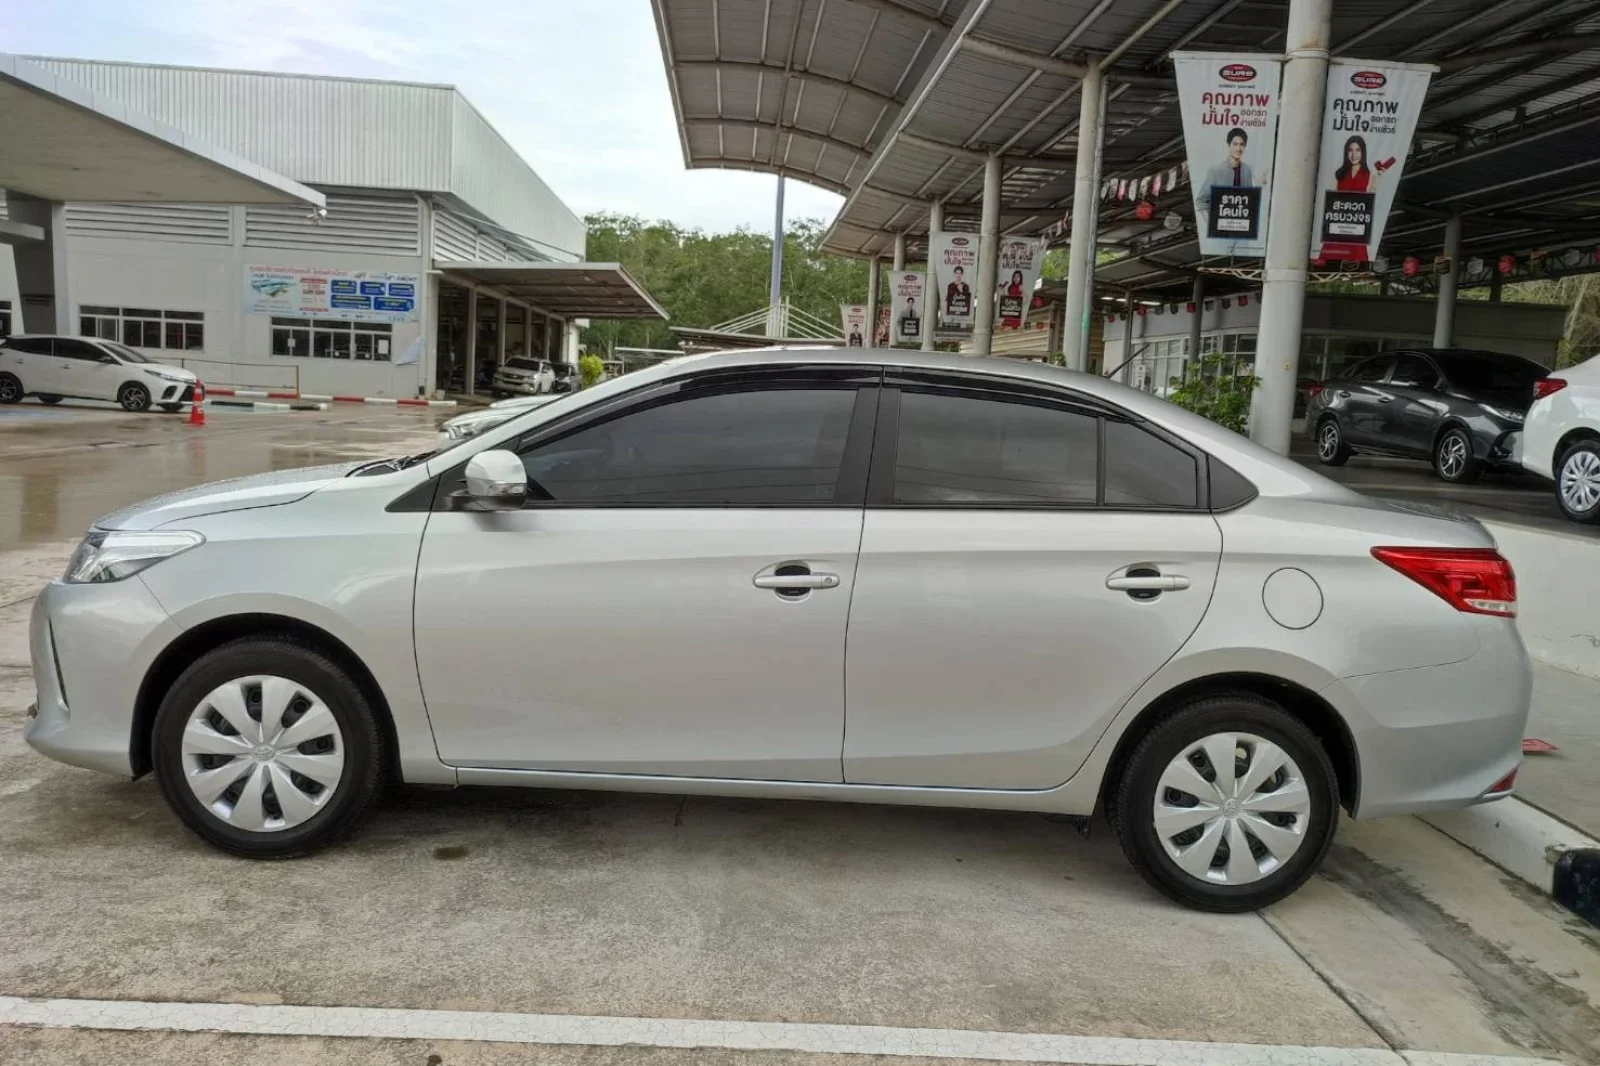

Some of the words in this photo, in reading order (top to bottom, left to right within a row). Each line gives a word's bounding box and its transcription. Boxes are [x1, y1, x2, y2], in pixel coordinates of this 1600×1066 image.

[1202, 92, 1269, 109] คุณภาพ
[1333, 98, 1399, 115] คุณภาพ
[1202, 107, 1240, 126] มั่นใจ
[1333, 113, 1370, 132] มั่นใจ
[1221, 194, 1249, 205] ราคา
[1333, 201, 1366, 211] สะดวก
[1219, 204, 1249, 218] โดนใจ
[1325, 212, 1371, 223] ครบวงจร
